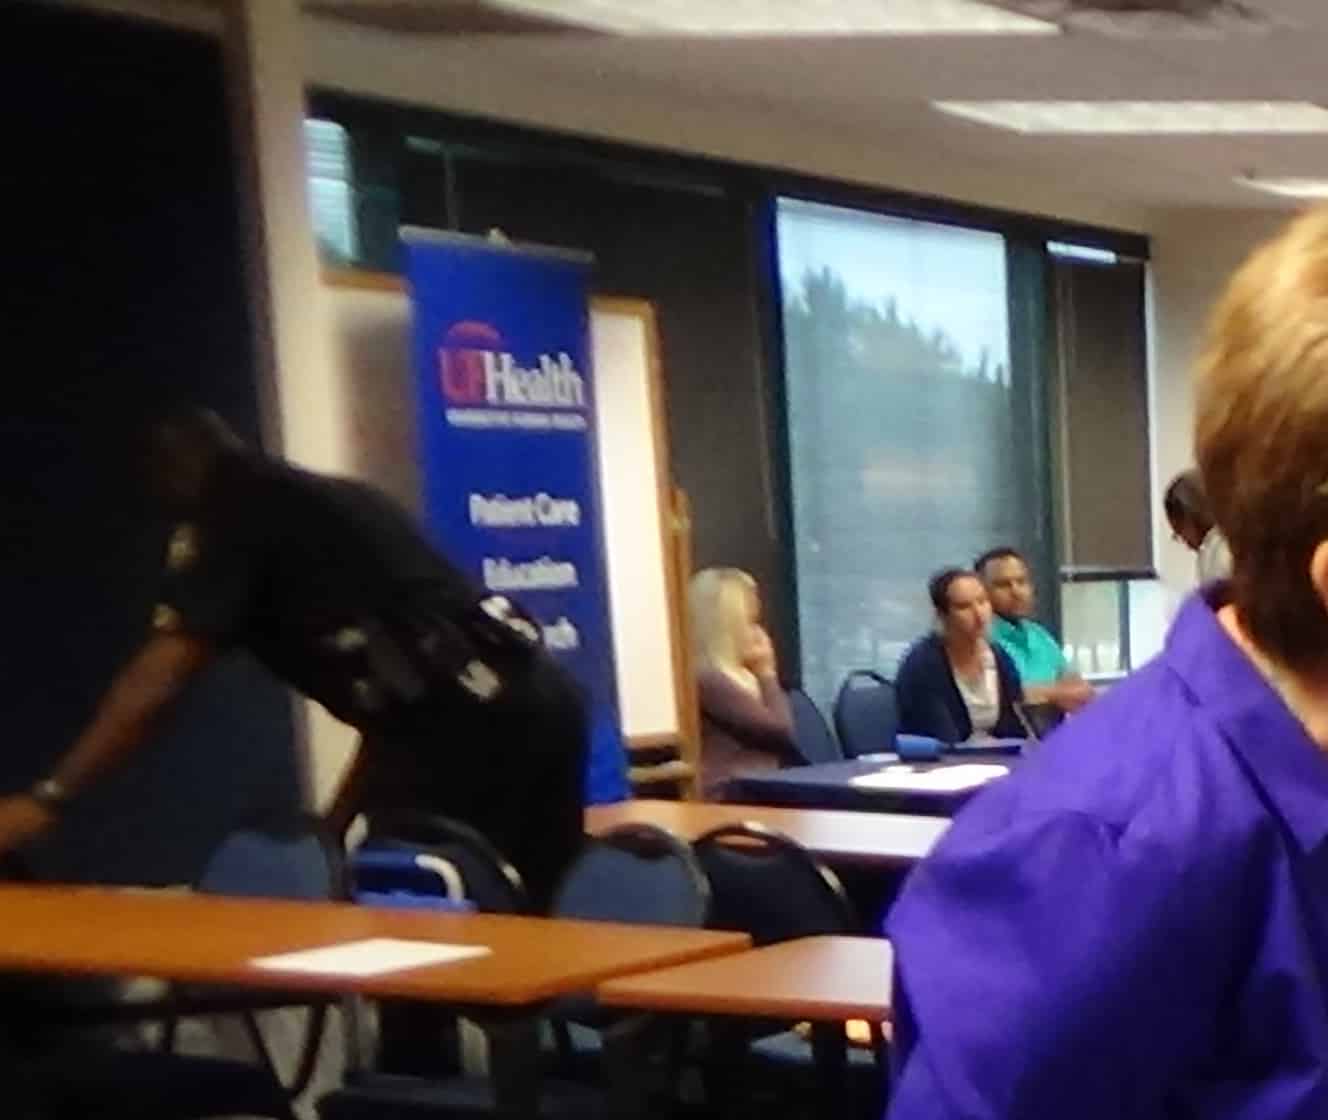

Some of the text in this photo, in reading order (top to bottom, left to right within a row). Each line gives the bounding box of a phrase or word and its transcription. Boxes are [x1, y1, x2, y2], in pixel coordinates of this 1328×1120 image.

[469, 492, 581, 527] Patient Care
[482, 555, 579, 591] Education
